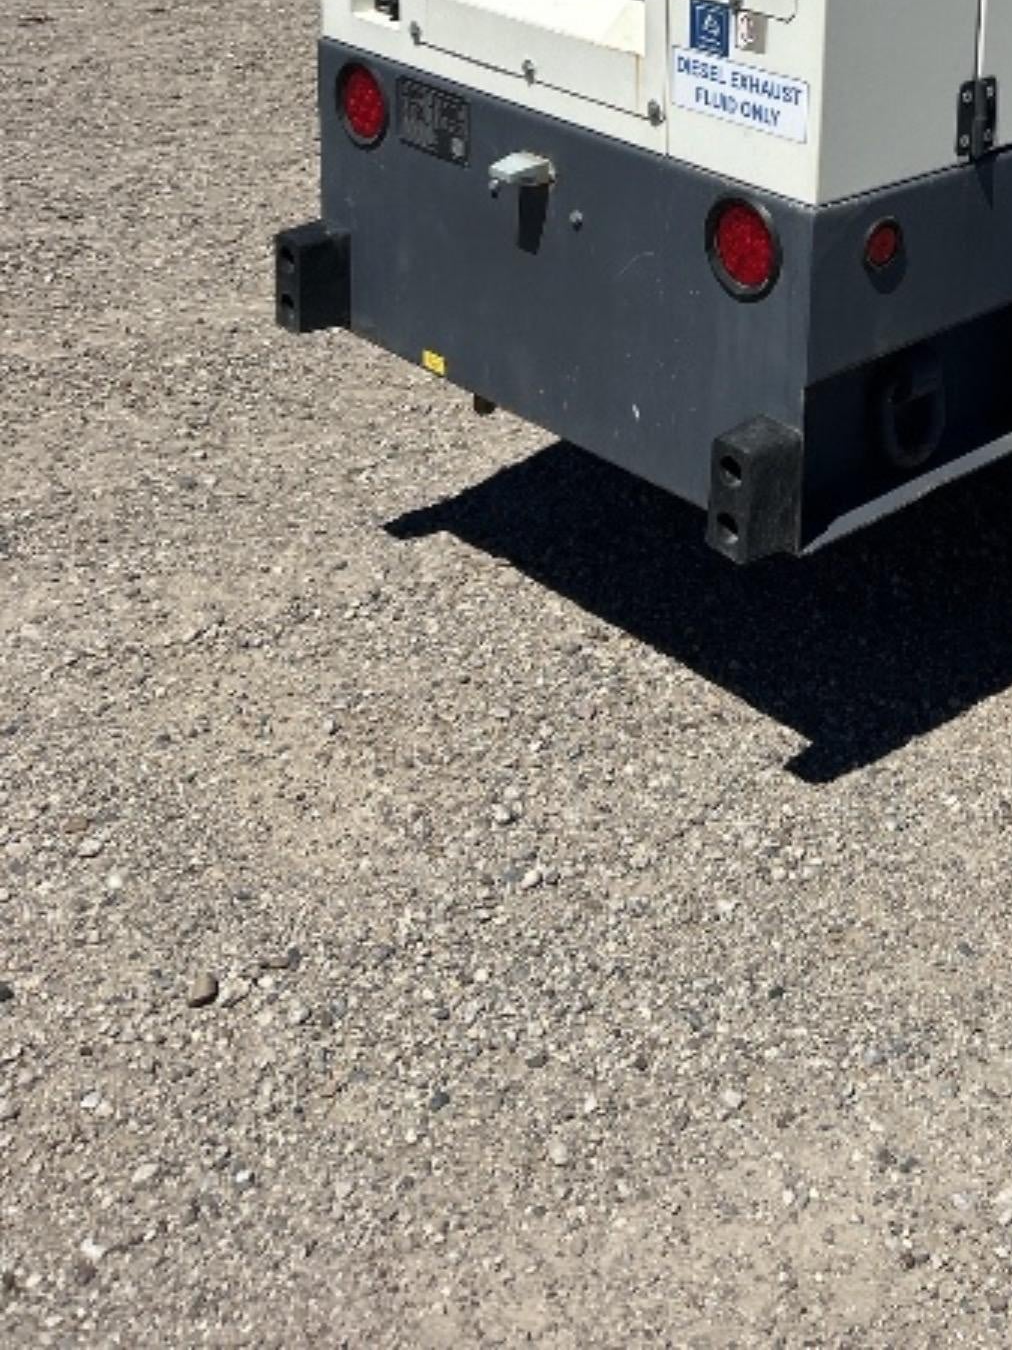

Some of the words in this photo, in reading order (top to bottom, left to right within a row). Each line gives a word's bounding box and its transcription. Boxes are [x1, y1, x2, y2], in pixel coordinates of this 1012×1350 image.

[677, 56, 727, 84] DIESEL
[731, 71, 804, 106] EXHAUST
[695, 87, 738, 114] FLUID
[740, 101, 781, 127] ONLY
